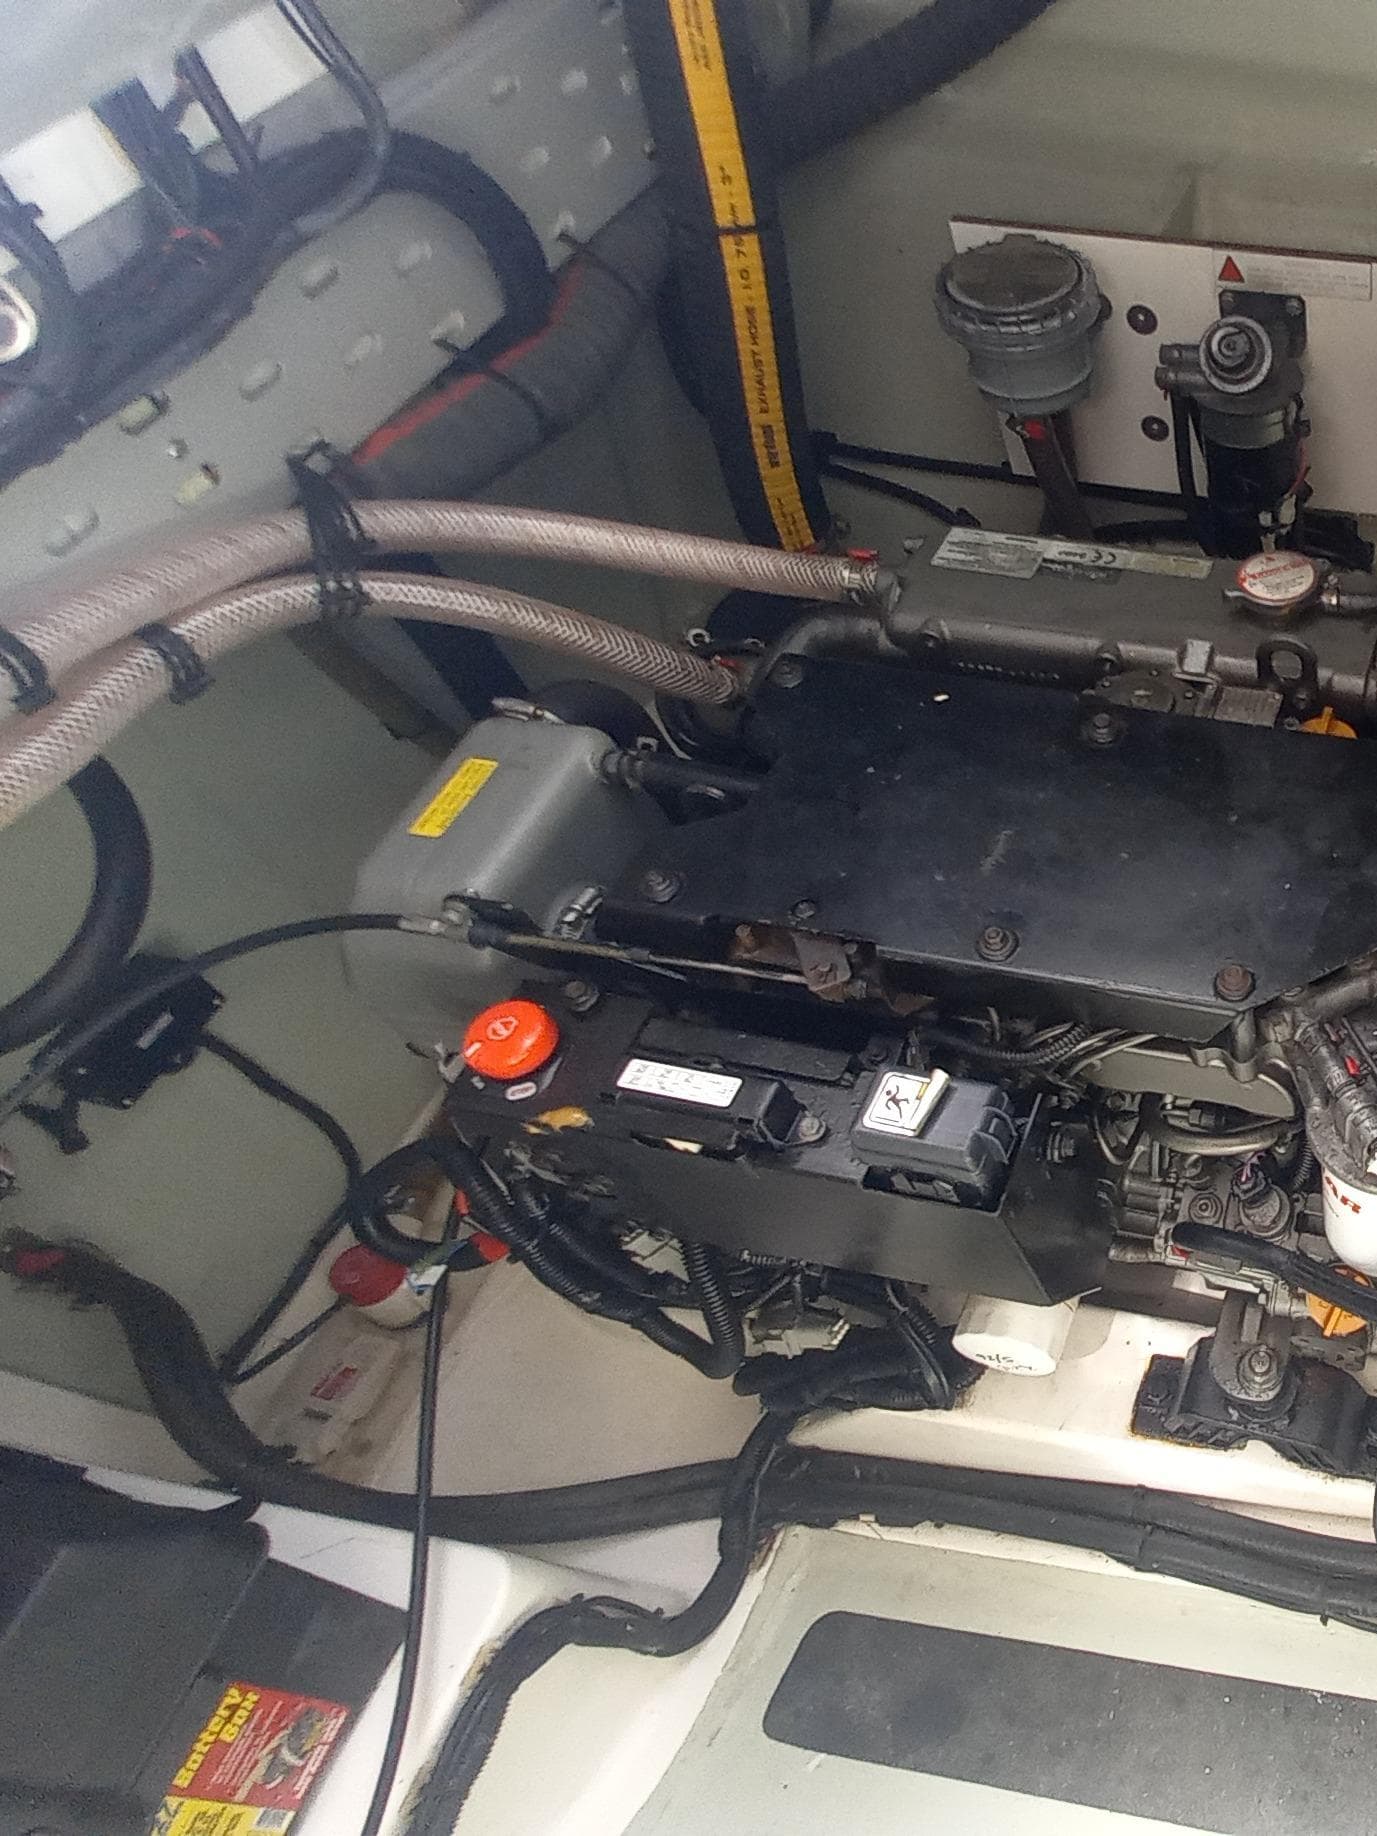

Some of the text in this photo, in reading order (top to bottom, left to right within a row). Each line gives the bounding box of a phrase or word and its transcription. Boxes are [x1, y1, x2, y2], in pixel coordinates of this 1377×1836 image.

[751, 349, 770, 414] EXHAUST
[1324, 1176, 1361, 1214] AR
[171, 1686, 242, 1789] Battery
[218, 1691, 261, 1744] Box
